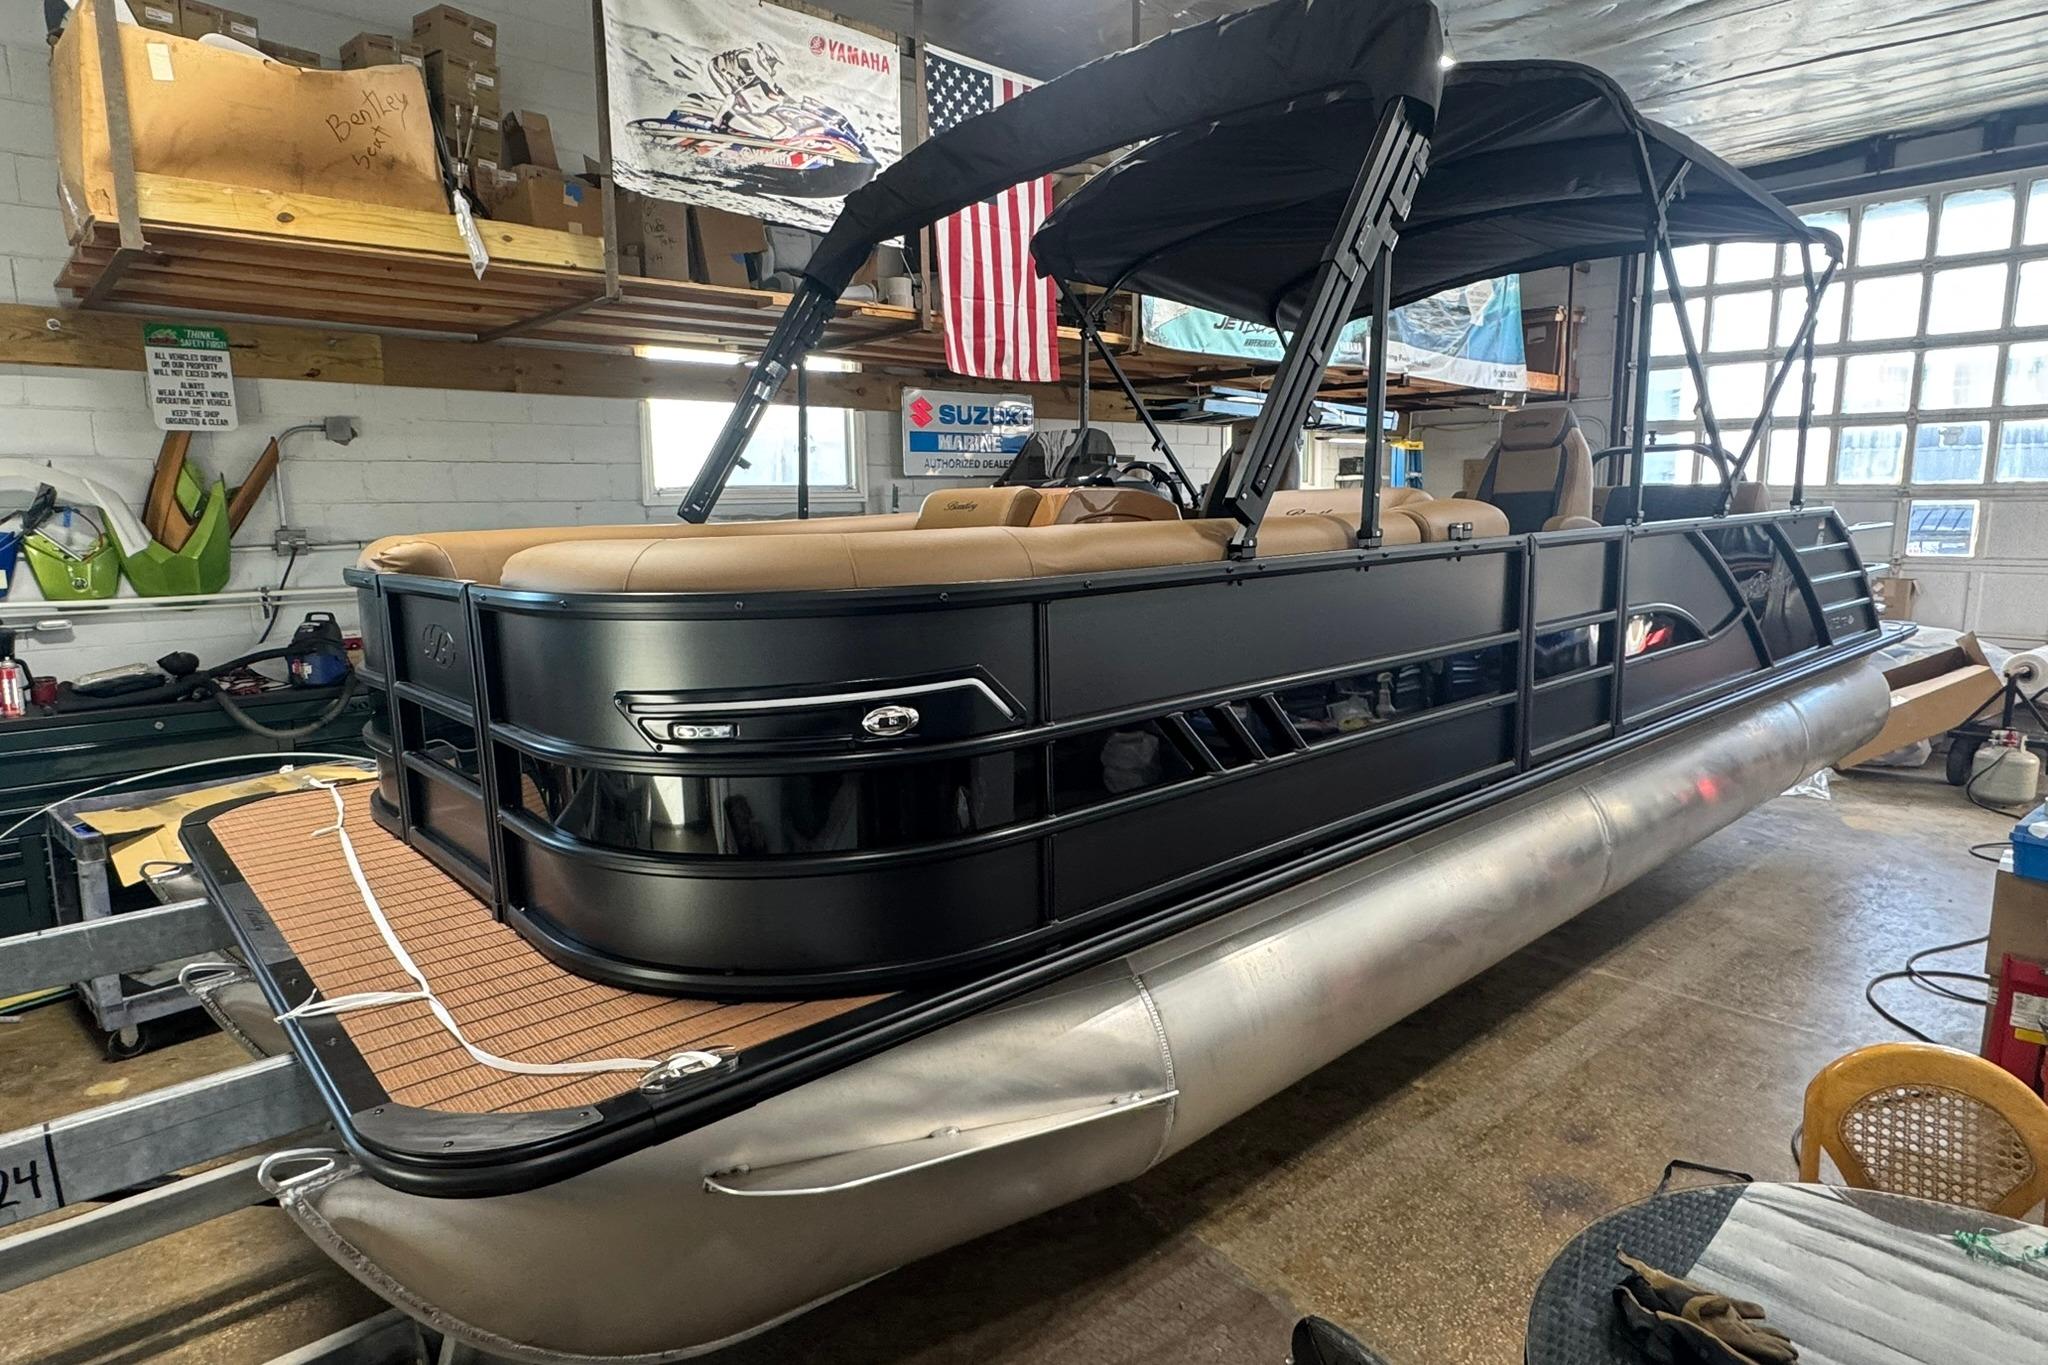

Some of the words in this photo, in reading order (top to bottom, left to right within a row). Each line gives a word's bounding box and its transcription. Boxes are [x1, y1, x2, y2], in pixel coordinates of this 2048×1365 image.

[828, 39, 890, 75] YAMAHA
[180, 338, 205, 348] SAFETY
[154, 352, 167, 360] ALL
[168, 353, 199, 361] VEHICLES
[186, 362, 218, 370] PROPERTY
[153, 368, 170, 376] WILL
[184, 390, 209, 398] HELMET
[210, 391, 230, 399] WHEN
[156, 397, 191, 405] OPERATING
[206, 399, 232, 407] VEHICLE
[172, 409, 188, 417] KEEP
[938, 404, 1032, 425] SUZUKI
[165, 417, 200, 425] ORGANIZED
[208, 418, 229, 426] CLEAN
[938, 433, 1003, 452] MARINE
[924, 458, 980, 469] AUTHORIZED
